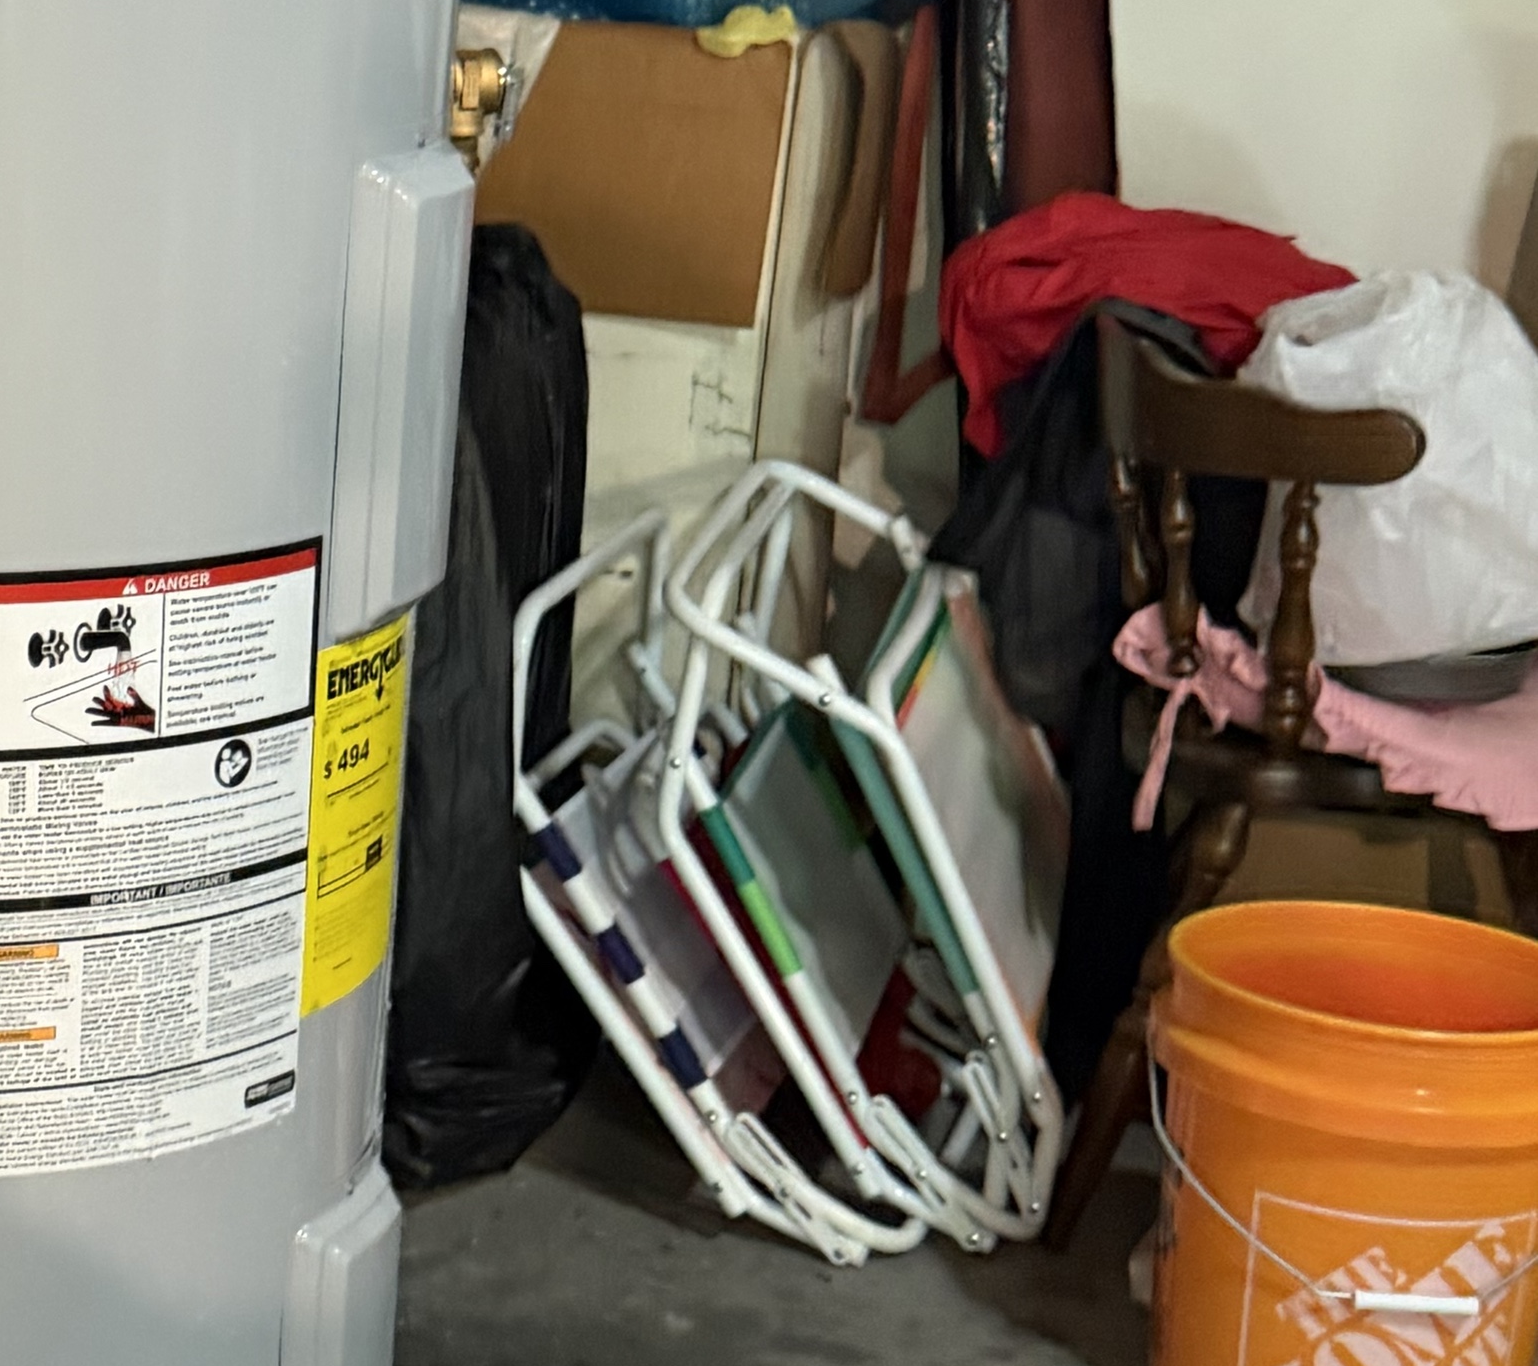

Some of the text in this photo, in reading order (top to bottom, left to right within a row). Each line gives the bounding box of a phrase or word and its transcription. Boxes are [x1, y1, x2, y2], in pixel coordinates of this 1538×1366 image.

[145, 572, 211, 593] DANGER
[338, 737, 370, 771] 494
[90, 887, 156, 906] IMPORTANT
[165, 873, 231, 895] IMPORTANTE
